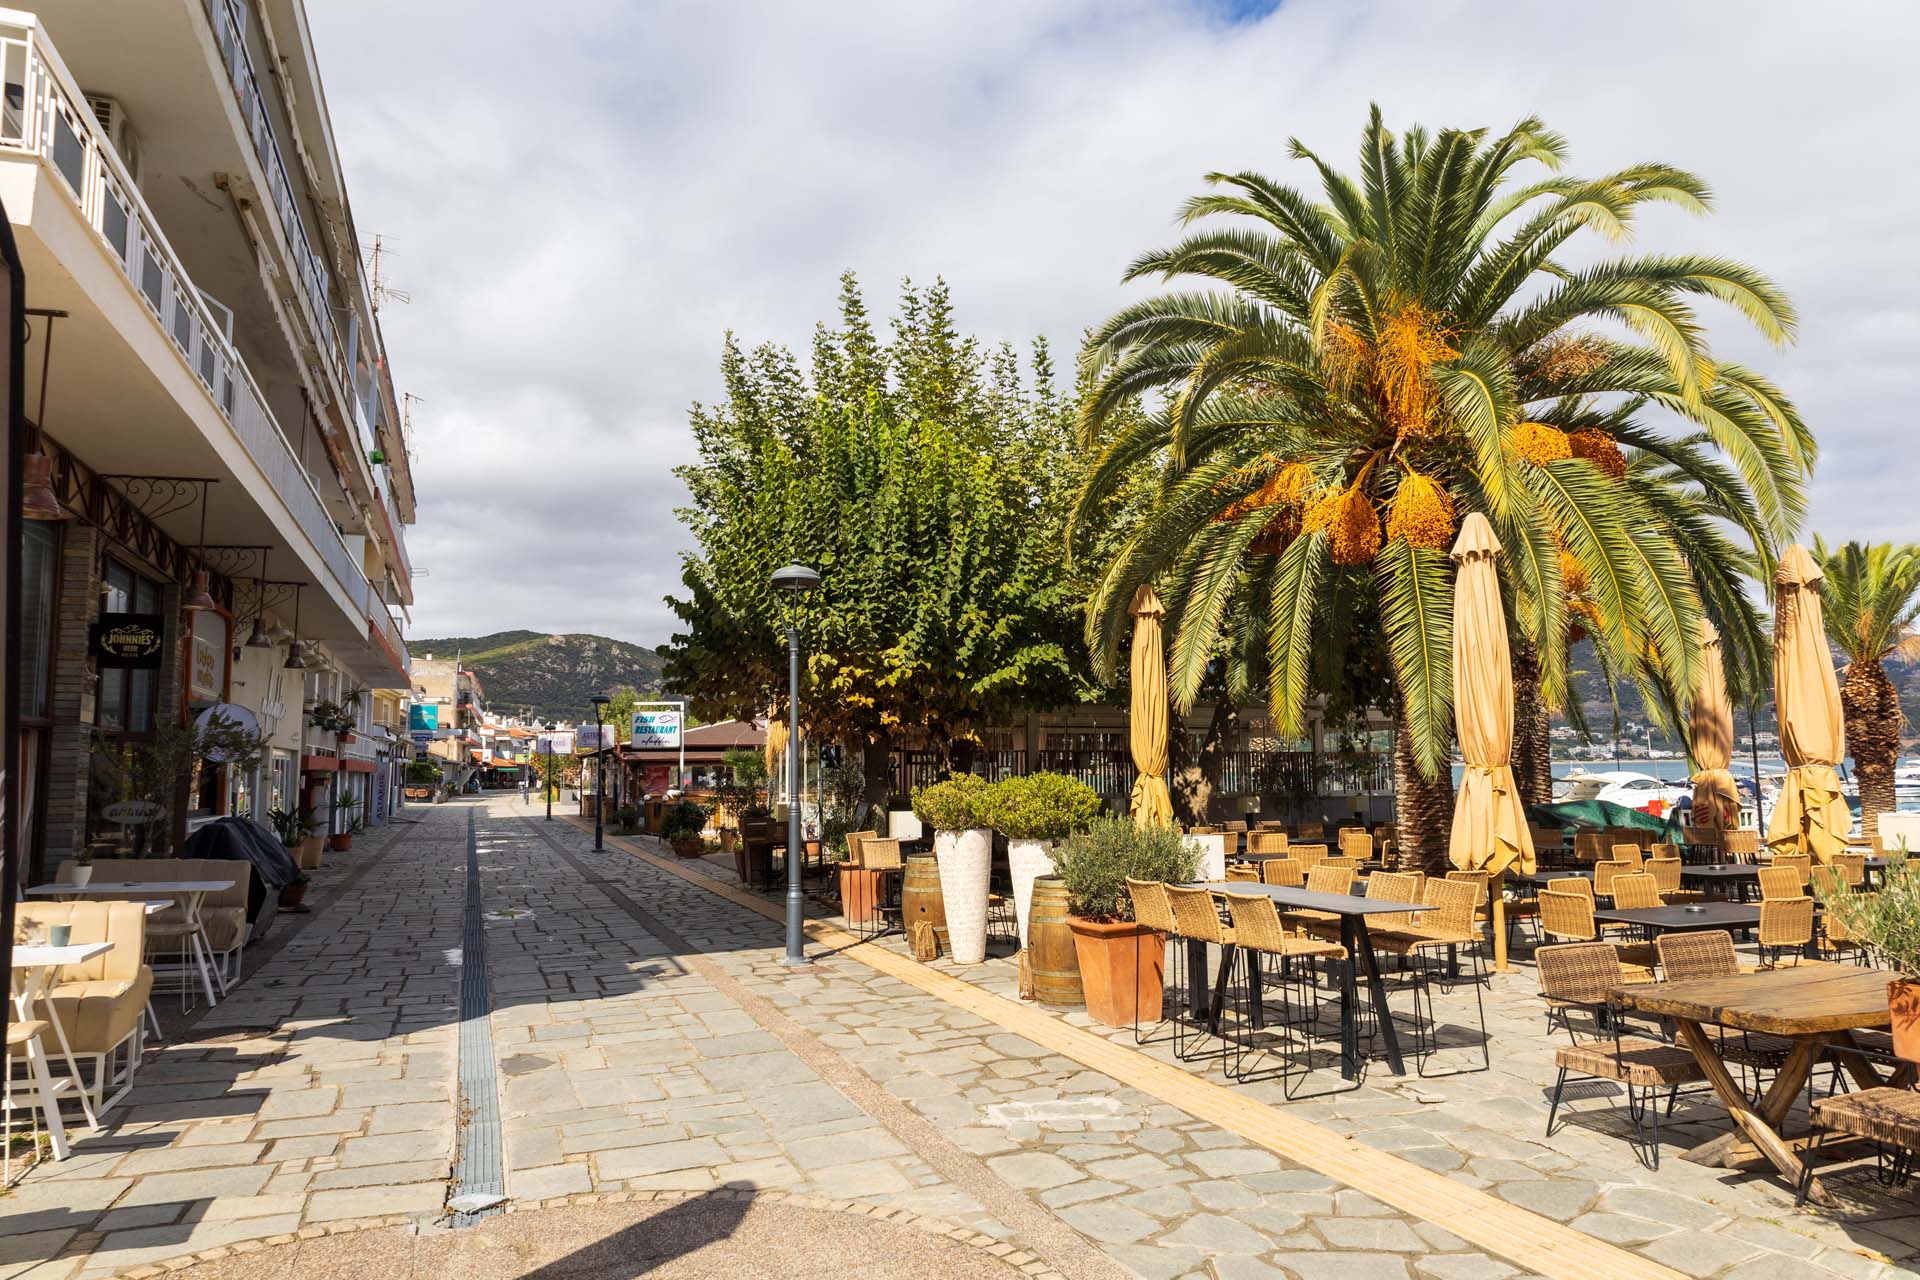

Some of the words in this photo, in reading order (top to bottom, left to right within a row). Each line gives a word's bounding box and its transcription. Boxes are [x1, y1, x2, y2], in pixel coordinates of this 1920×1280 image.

[108, 633, 154, 646] JOHNNIES'
[634, 715, 656, 724] FISH
[634, 725, 678, 735] RESTAURANT
